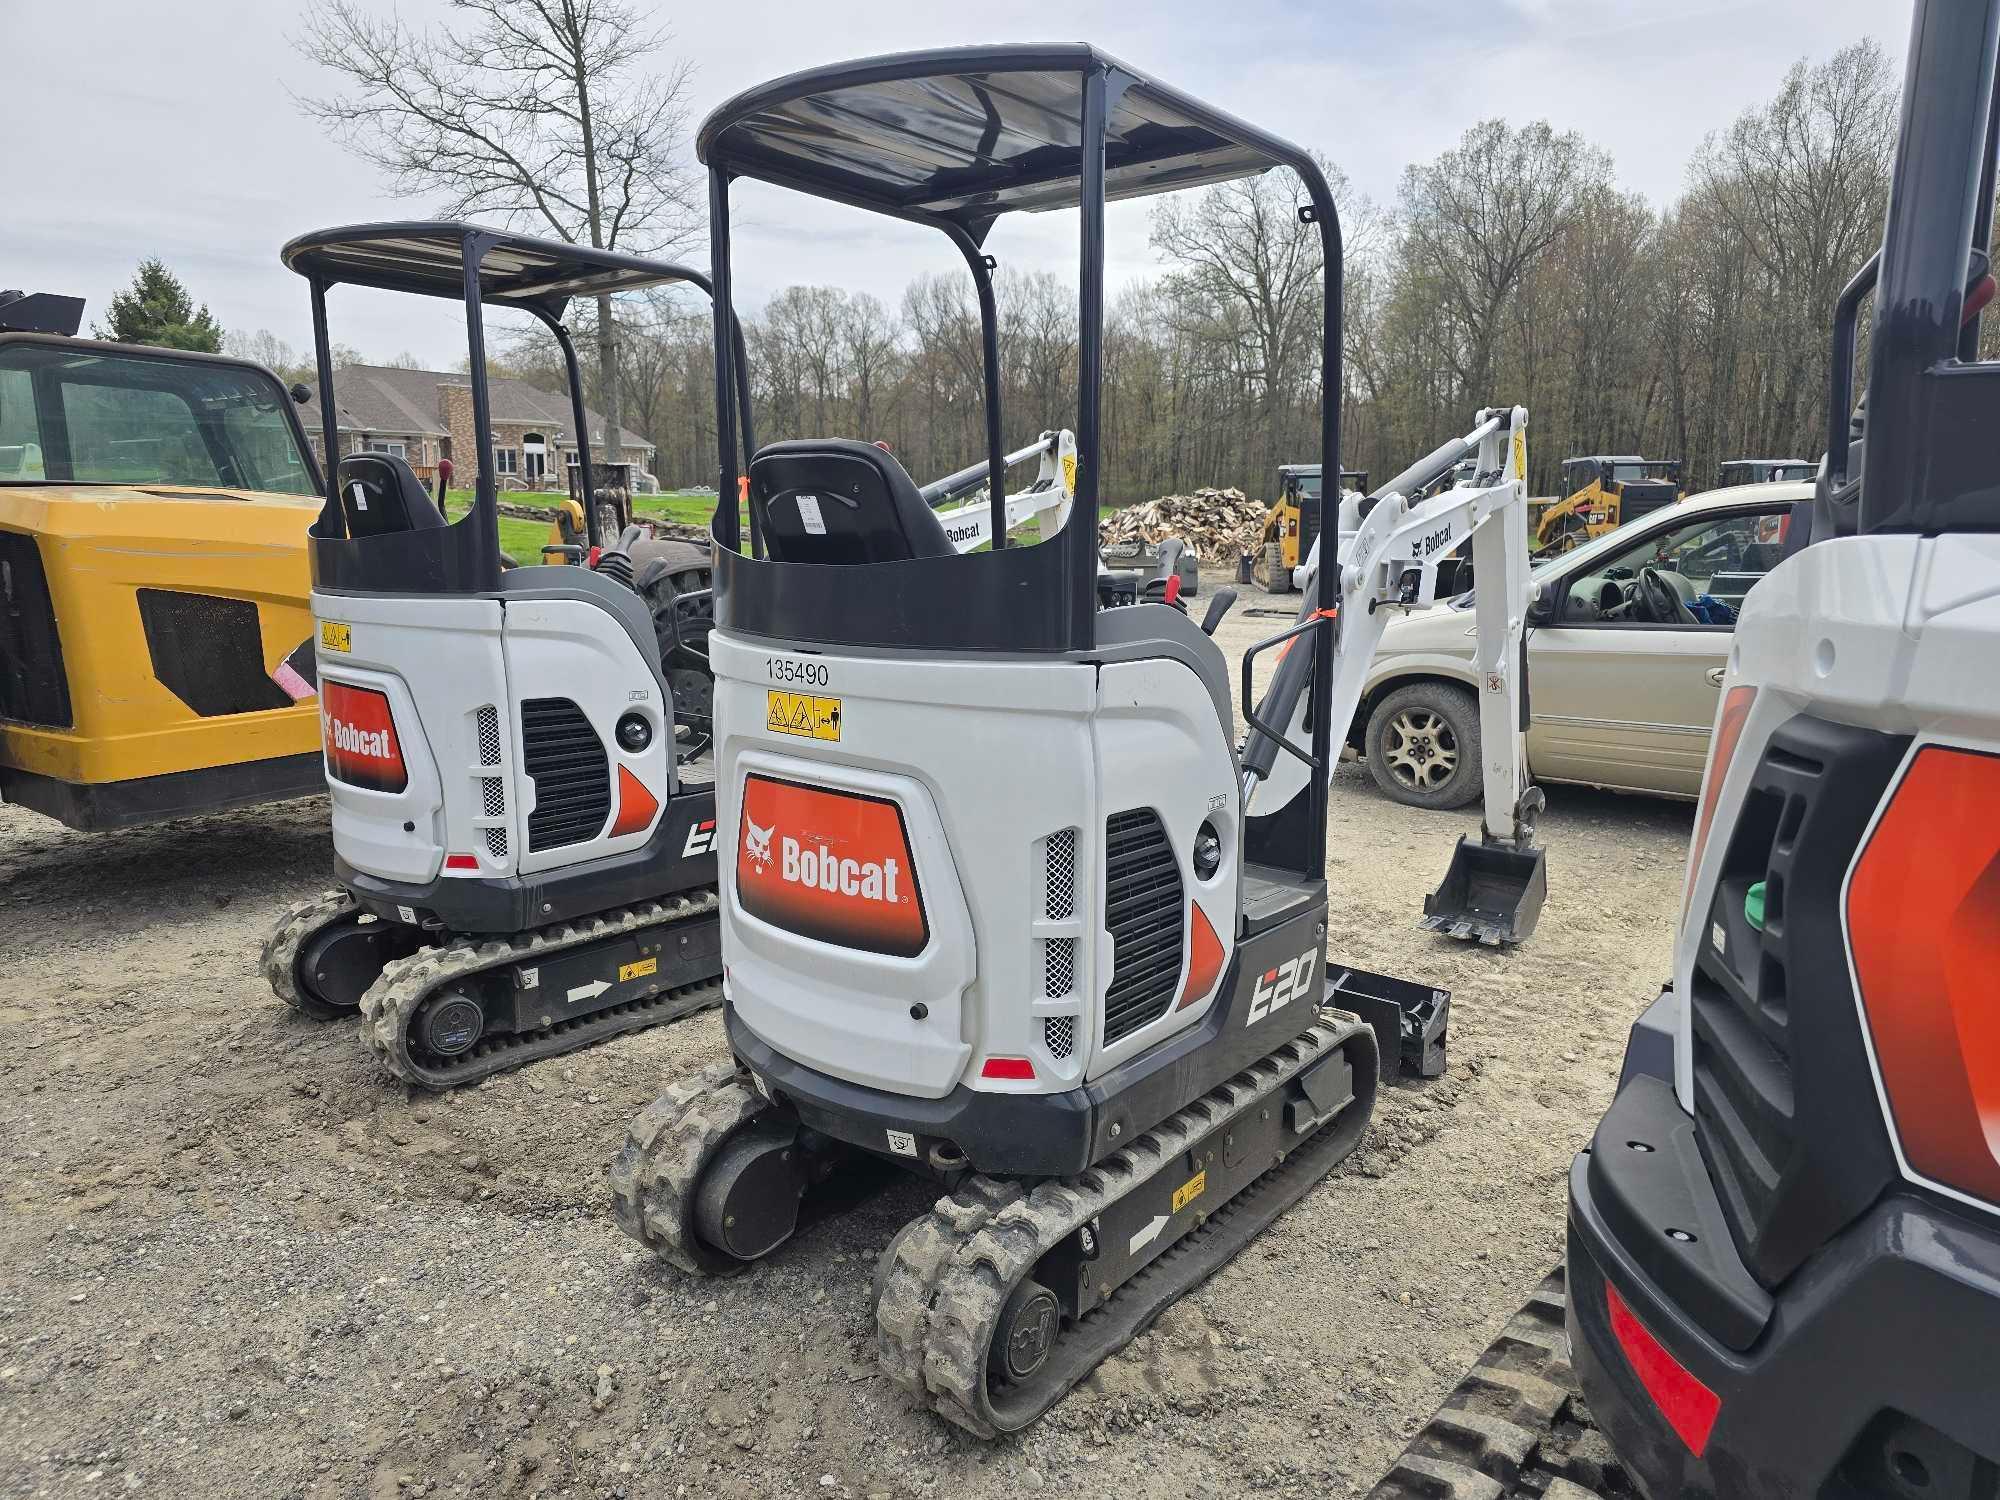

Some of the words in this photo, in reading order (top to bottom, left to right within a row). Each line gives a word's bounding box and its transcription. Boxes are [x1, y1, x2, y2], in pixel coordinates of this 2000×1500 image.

[946, 522, 980, 542] Bobcat
[1425, 522, 1452, 556] Bobcat
[766, 657, 829, 687] 135490
[333, 718, 391, 759] Bobcat
[681, 820, 717, 858] E
[782, 836, 899, 903] Bobcat
[1245, 946, 1318, 1028] E20
